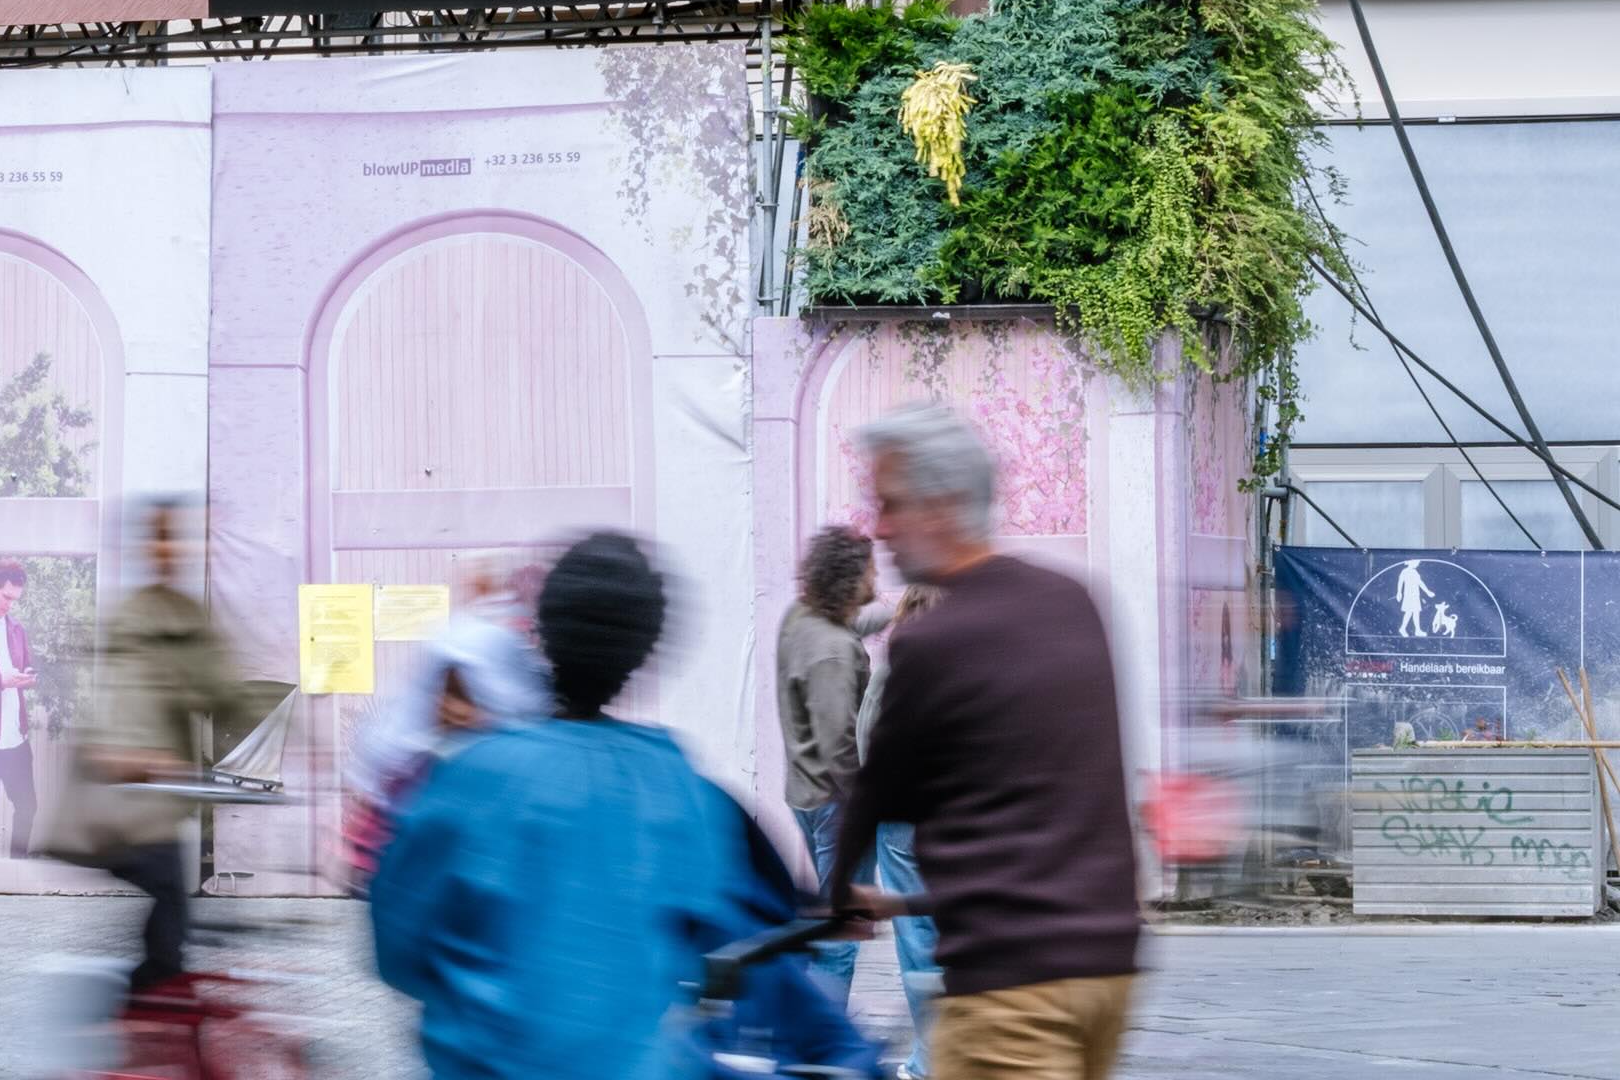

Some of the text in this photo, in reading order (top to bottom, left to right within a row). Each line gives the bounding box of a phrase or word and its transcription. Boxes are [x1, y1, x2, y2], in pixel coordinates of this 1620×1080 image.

[511, 154, 517, 165] 3
[522, 153, 544, 164] 236
[548, 152, 562, 163] 55
[566, 151, 581, 163] 59
[8, 171, 29, 183] 236
[32, 171, 46, 182] 55
[50, 171, 64, 182] 59
[1400, 661, 1453, 673] Handelaars
[1456, 663, 1506, 675] bereikbaar
